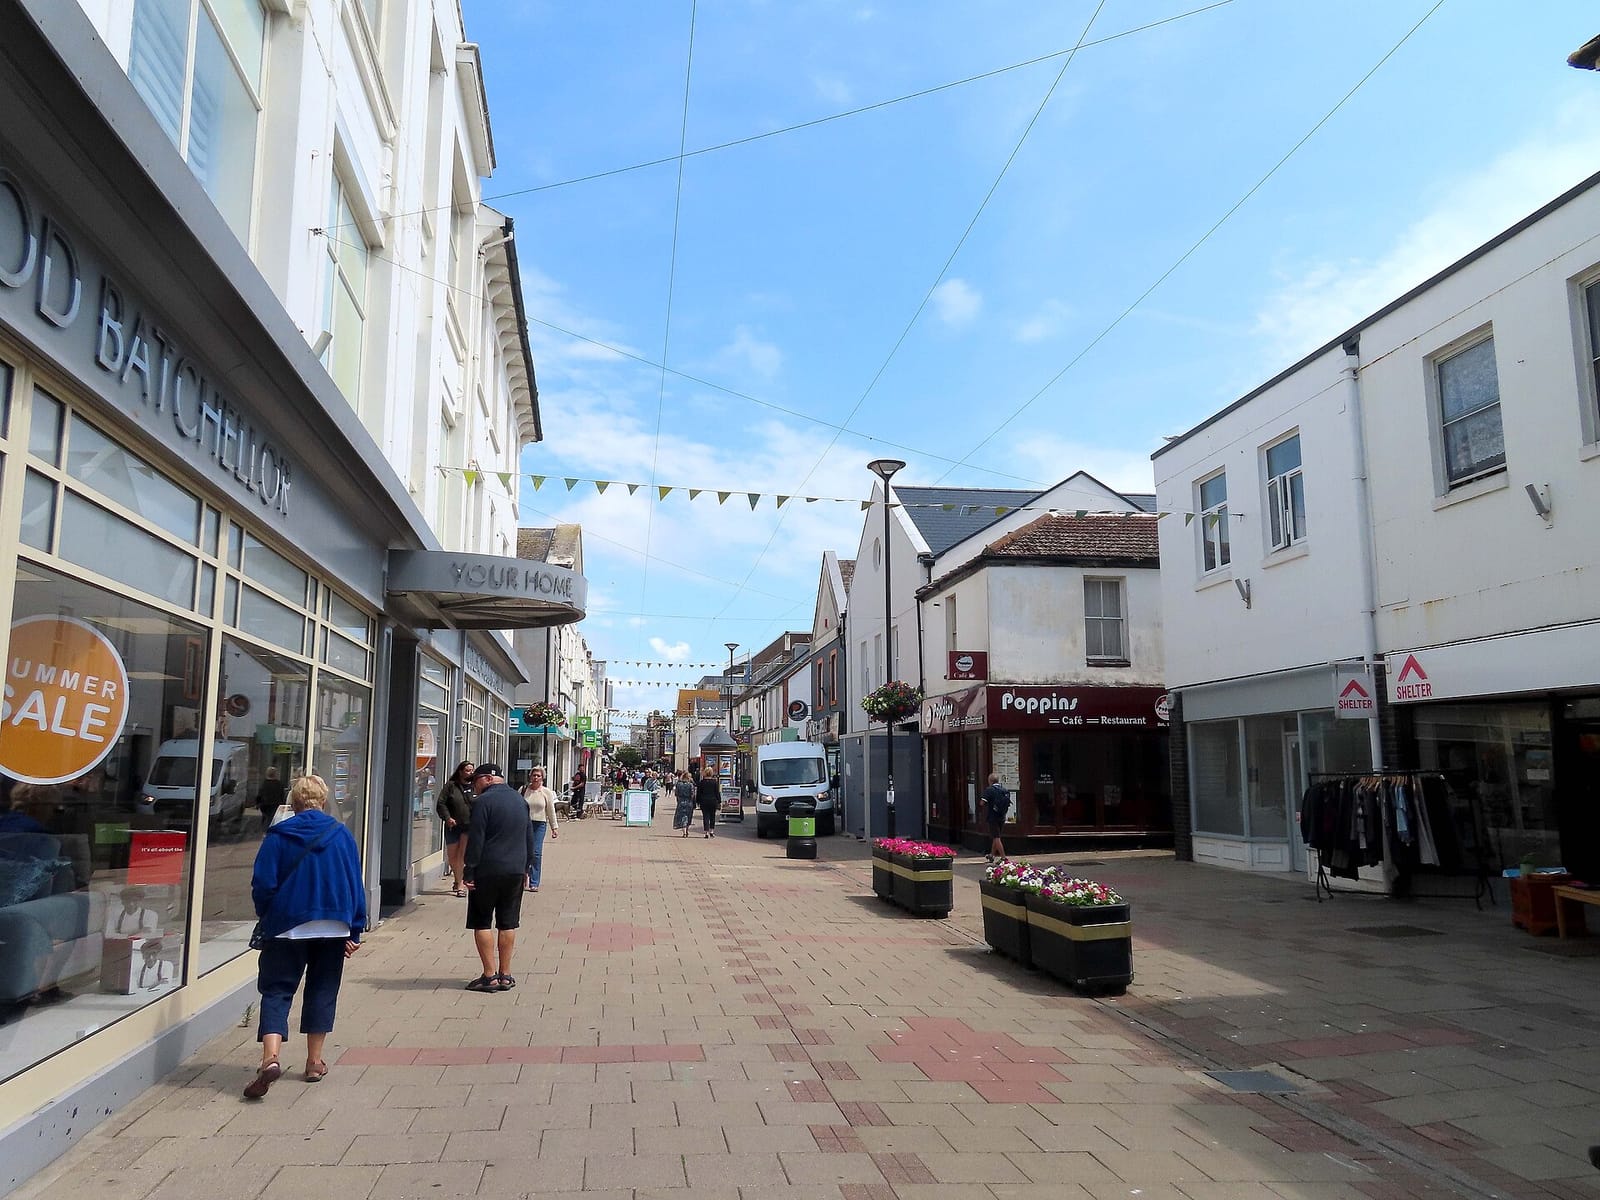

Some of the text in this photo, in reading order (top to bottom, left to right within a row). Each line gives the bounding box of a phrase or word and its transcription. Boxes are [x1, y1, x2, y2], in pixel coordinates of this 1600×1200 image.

[96, 275, 291, 516] BATCHELLOR
[450, 561, 573, 598] YOUR HOME
[1396, 683, 1433, 699] SHELTER
[1001, 692, 1078, 714] Poppins
[1338, 699, 1373, 709] SHELTER
[1061, 716, 1147, 725] Café Restaurant
